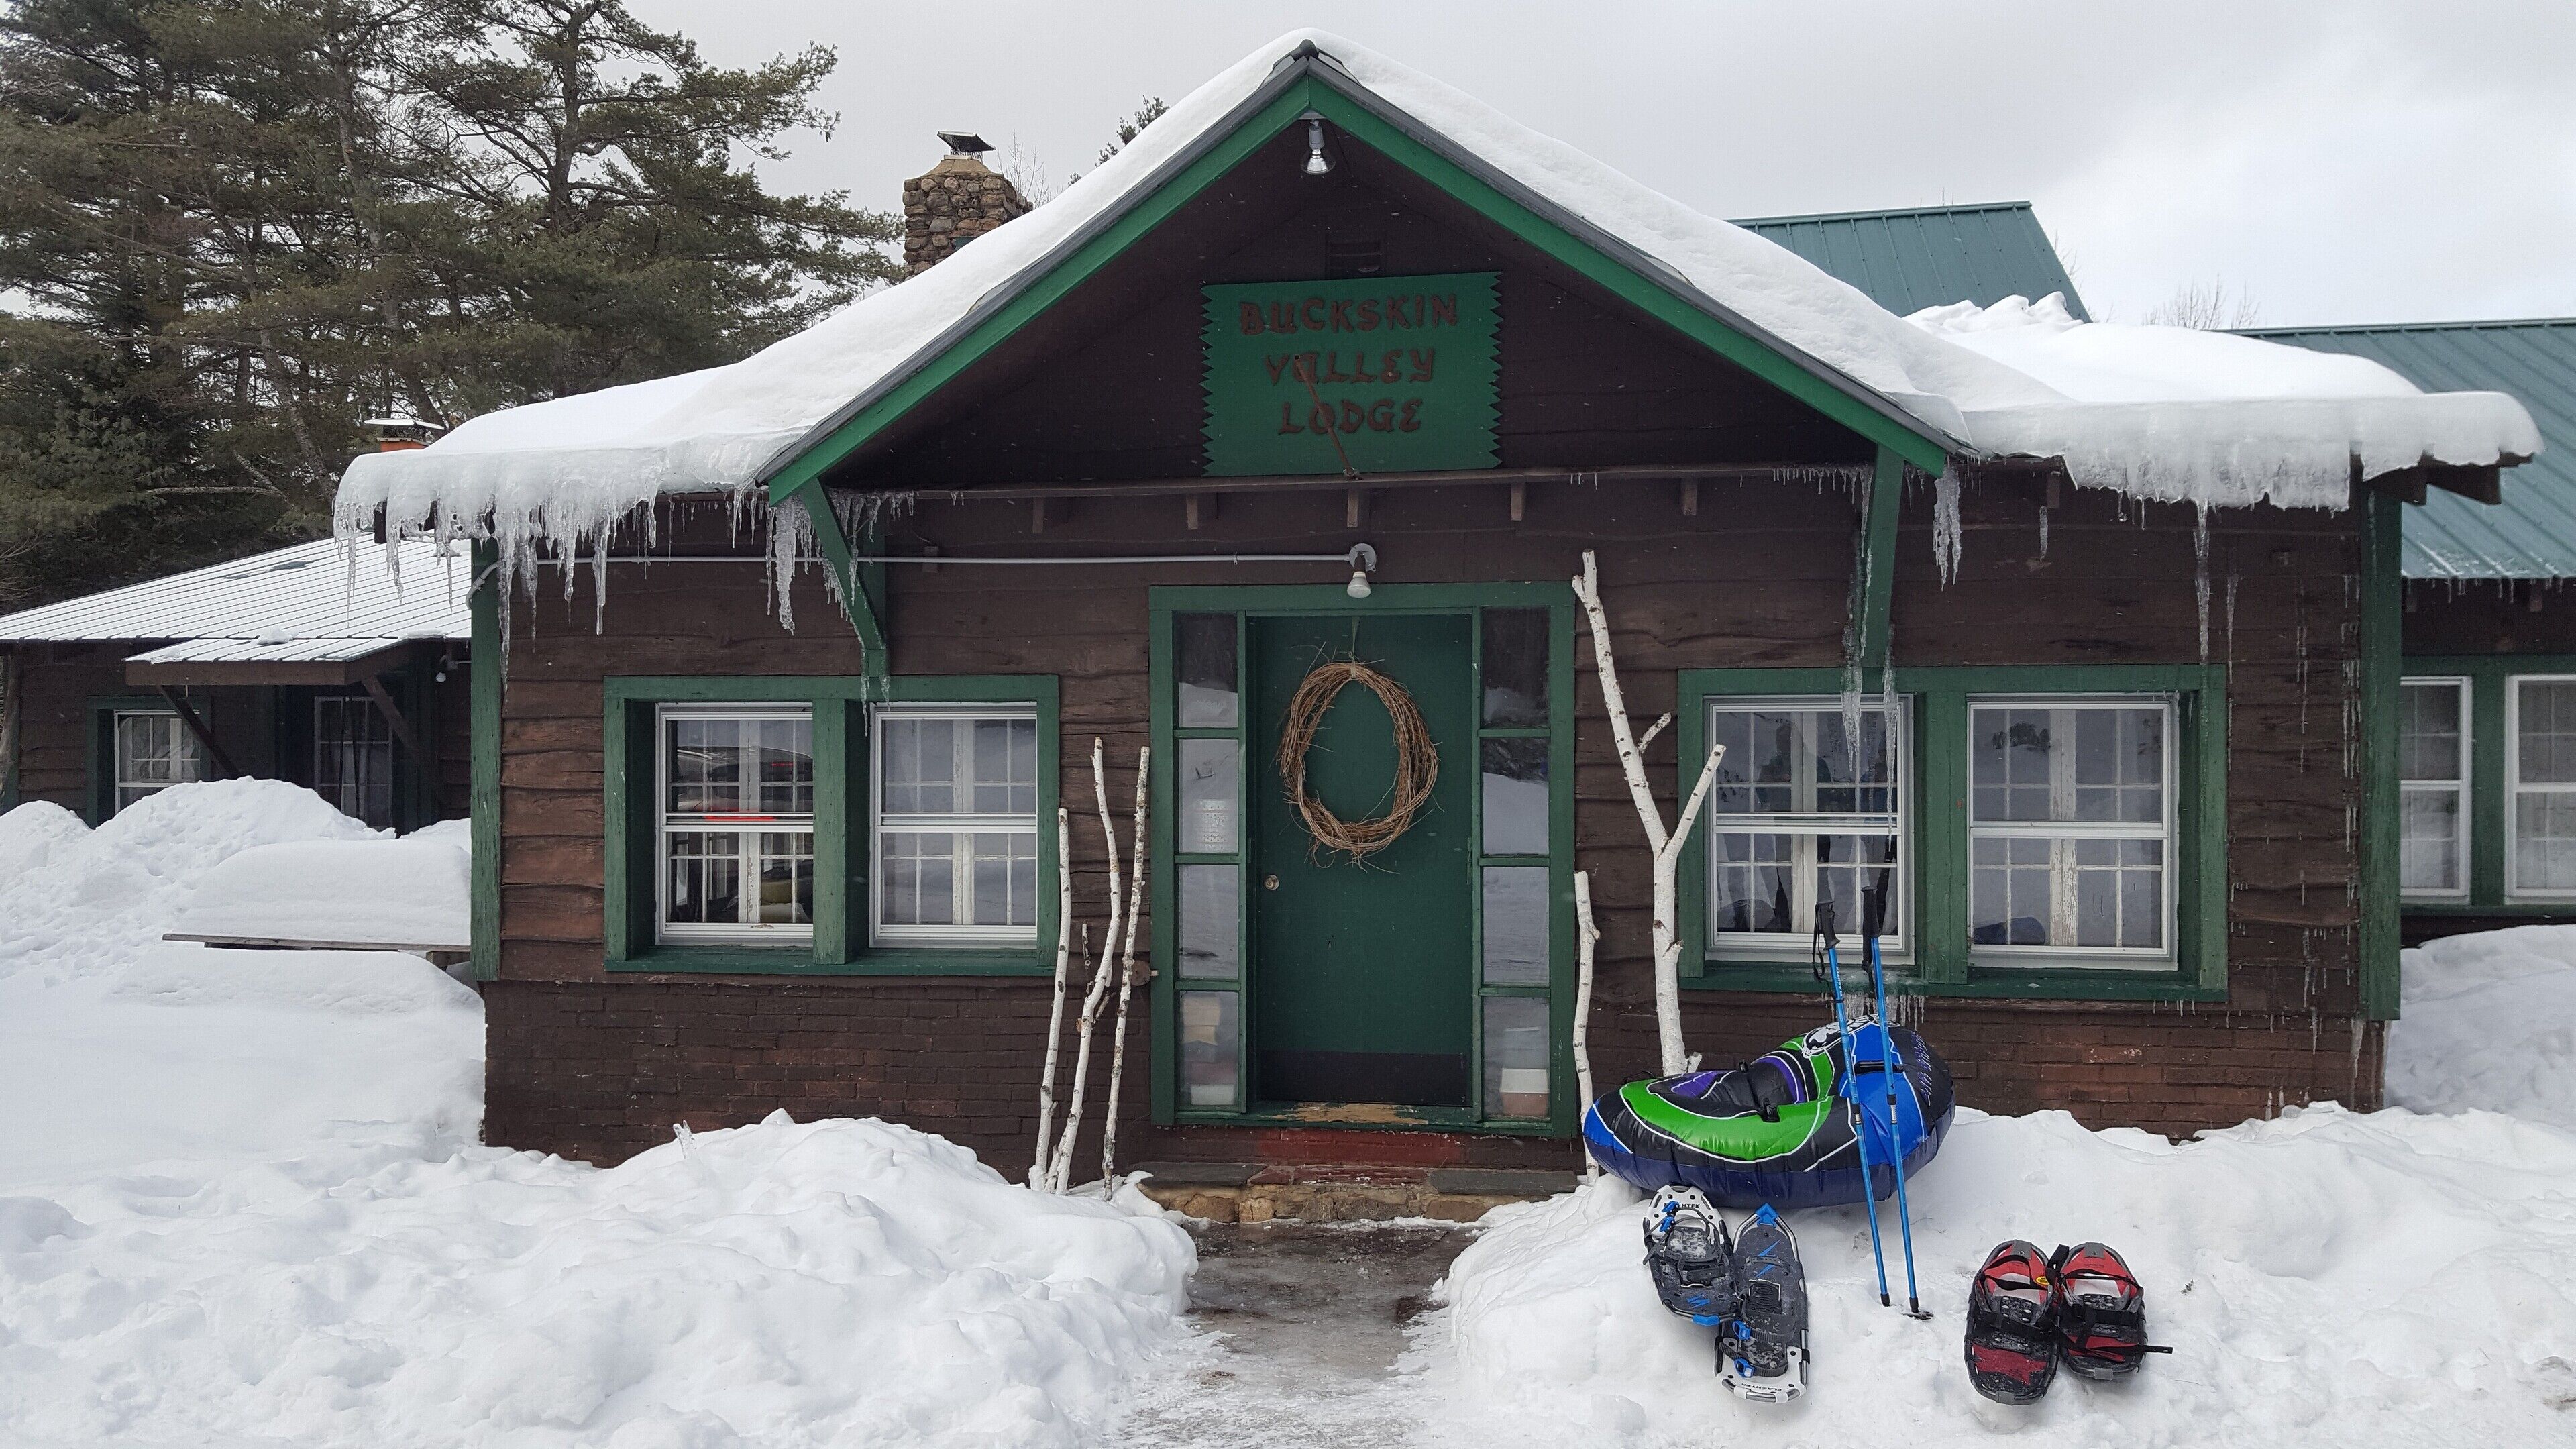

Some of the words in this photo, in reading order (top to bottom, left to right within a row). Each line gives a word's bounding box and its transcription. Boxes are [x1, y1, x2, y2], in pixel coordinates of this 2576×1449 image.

[1240, 294, 1458, 335] BUCKSKIN
[1265, 347, 1435, 386] VALLEY
[1278, 398, 1423, 435] LODGE
